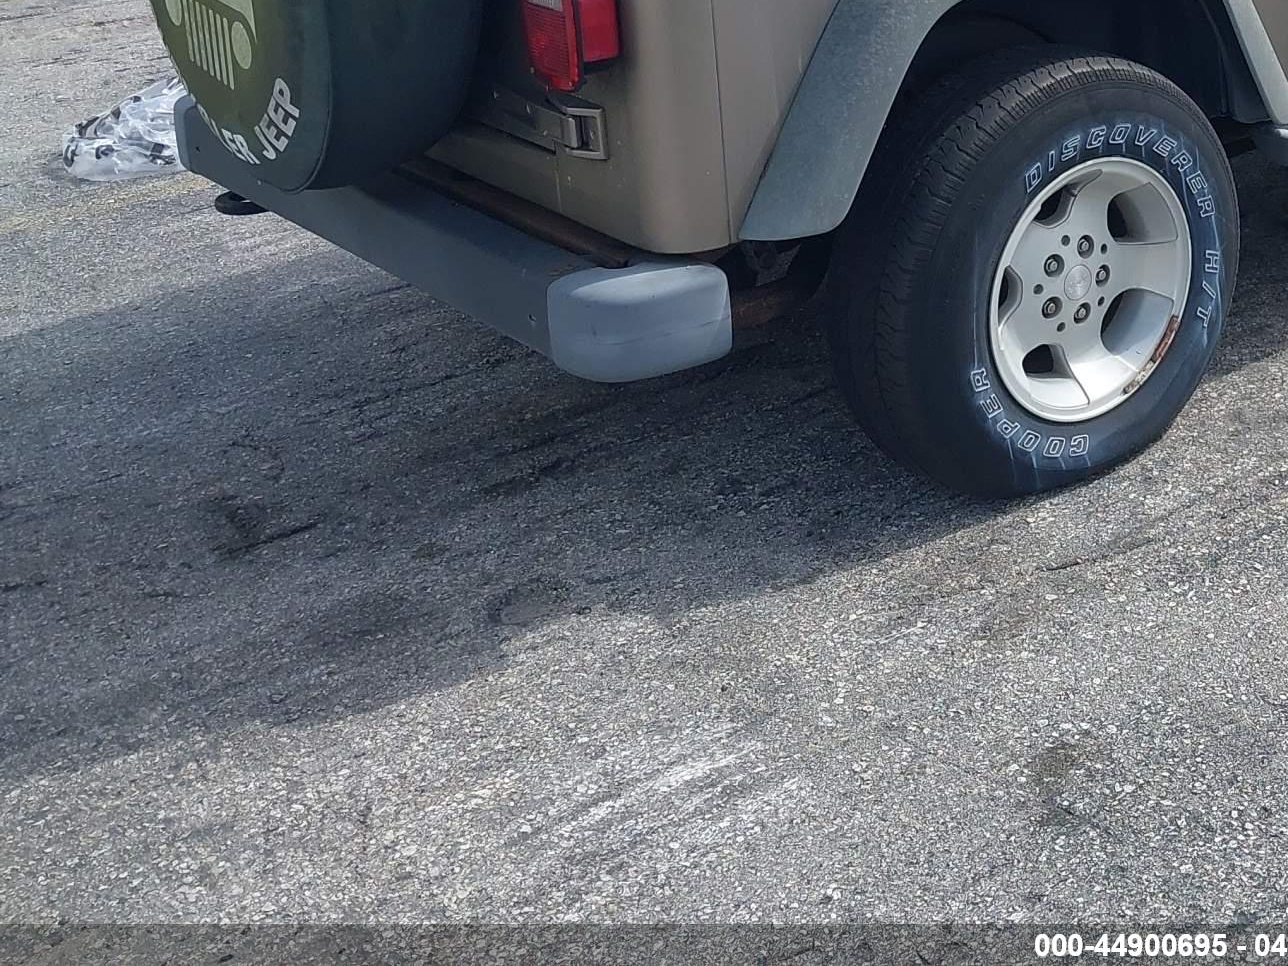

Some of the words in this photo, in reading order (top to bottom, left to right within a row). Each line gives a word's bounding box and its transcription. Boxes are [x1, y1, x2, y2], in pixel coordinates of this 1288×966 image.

[254, 77, 300, 160] JEEP
[1025, 122, 1217, 217] DISCOVERER
[1197, 248, 1220, 331] H/T
[970, 367, 1090, 458] COOPER
